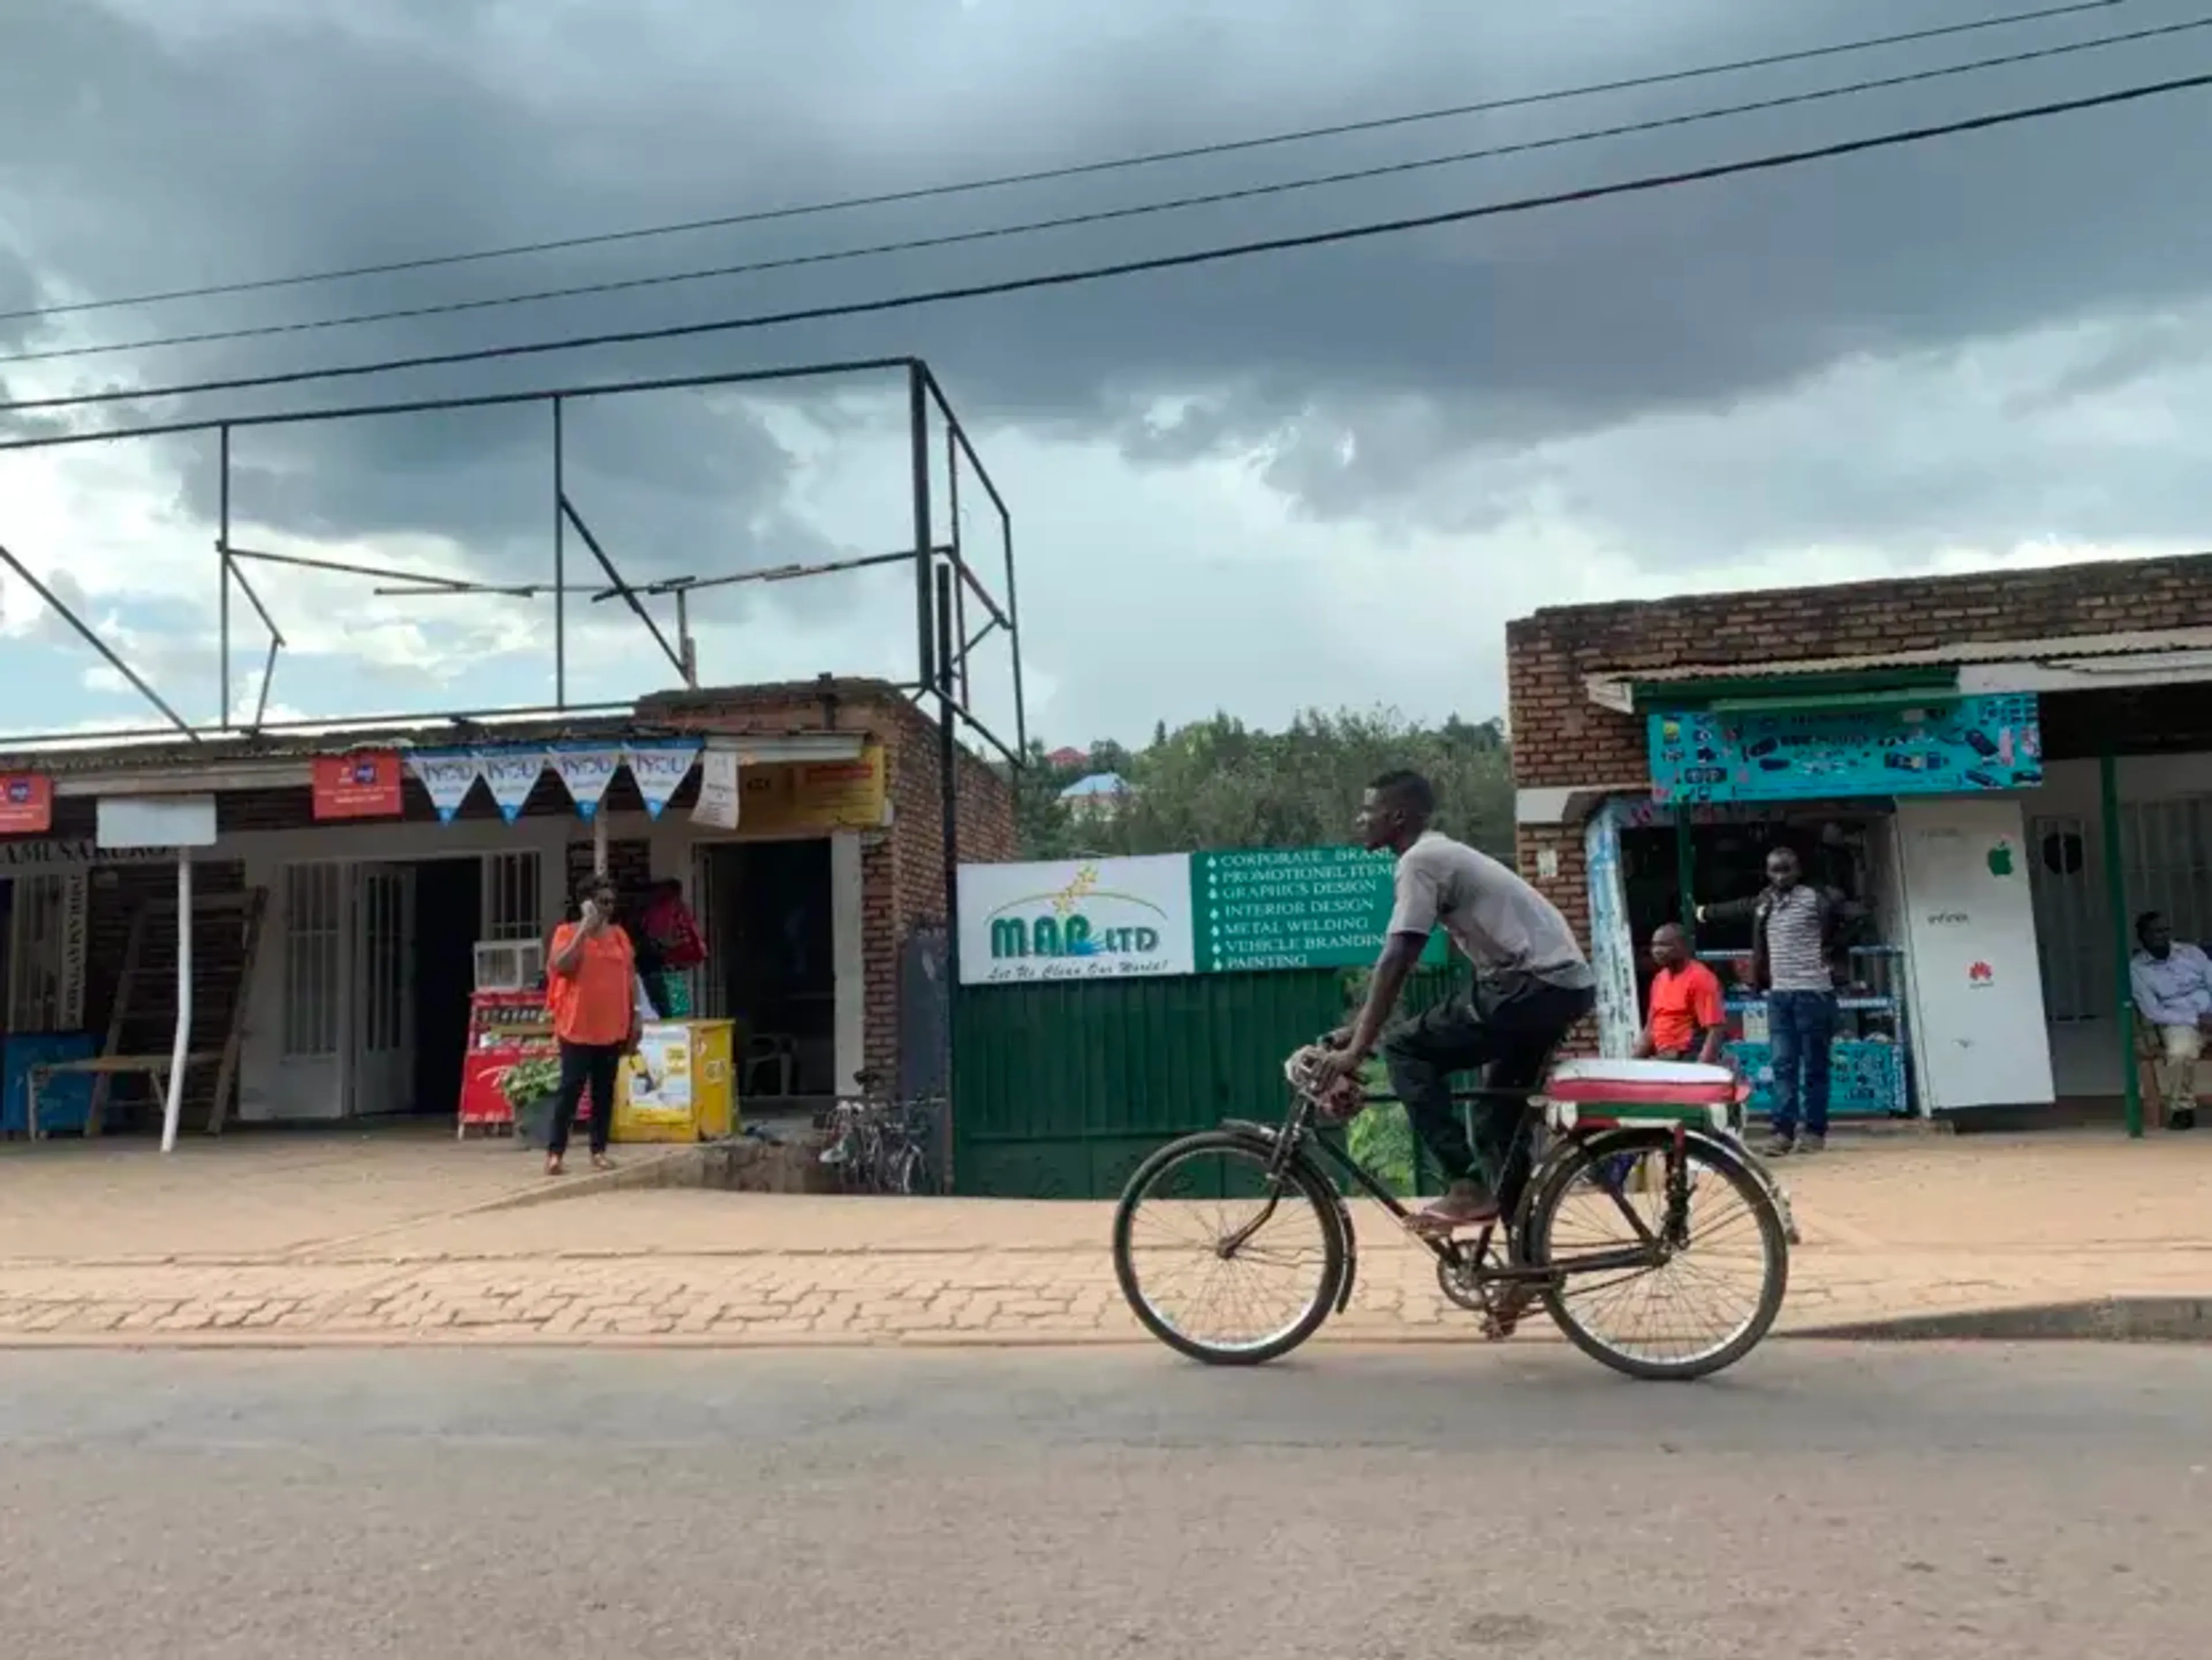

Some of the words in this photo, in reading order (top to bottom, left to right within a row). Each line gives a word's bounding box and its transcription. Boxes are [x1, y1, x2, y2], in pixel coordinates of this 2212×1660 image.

[1220, 851, 1322, 866] CORPORATE
[1223, 883, 1309, 899] GRAPHICS
[1313, 879, 1376, 895] DESIGN
[1225, 901, 1305, 918] INTERIOR
[1311, 897, 1374, 913] DESIGN
[1225, 920, 1281, 935] METAL
[1287, 916, 1369, 933] WELDING
[1106, 926, 1160, 954] LTD
[1225, 937, 1297, 954] VEHICLE
[1041, 961, 1081, 980] Clean
[1088, 962, 1112, 975] Our
[1228, 953, 1308, 970] PAINTING
